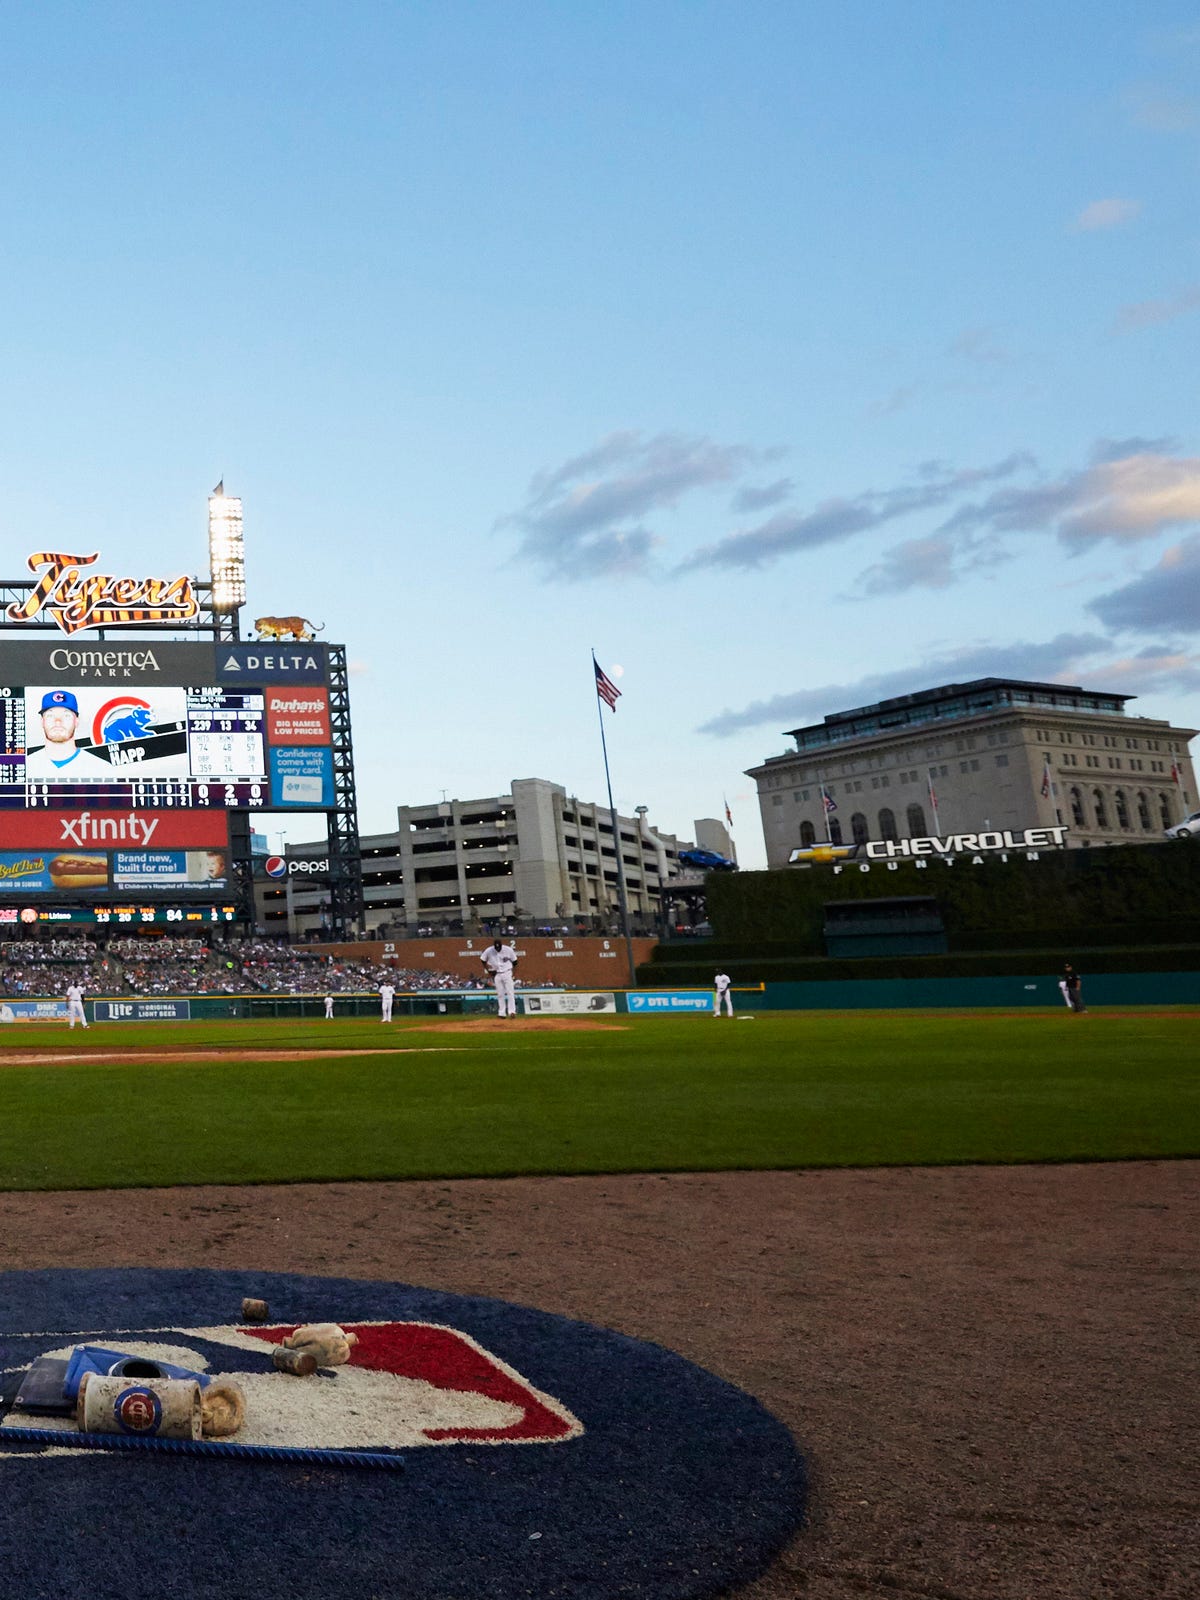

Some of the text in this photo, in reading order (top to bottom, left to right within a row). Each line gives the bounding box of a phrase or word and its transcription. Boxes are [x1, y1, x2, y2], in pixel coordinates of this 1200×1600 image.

[7, 551, 200, 637] Tigers
[247, 656, 318, 670] DELTA
[81, 668, 132, 676] PARK
[202, 687, 223, 696] HAPP
[270, 699, 325, 710] Dunham's
[191, 720, 211, 731] .239
[220, 720, 232, 731] 13
[245, 720, 257, 731] 34
[110, 747, 146, 766] HAPP
[276, 750, 324, 758] Confidence
[306, 758, 324, 766] with
[224, 764, 234, 772] 14
[180, 784, 186, 794] 2
[198, 784, 261, 798] 0 2 0
[153, 796, 159, 806] 3
[180, 796, 186, 806] 2
[60, 812, 160, 846] xfinity
[866, 826, 1068, 858] CHEVROLET
[118, 854, 172, 863] Brand new,
[833, 852, 1040, 875] FOUNTAIN
[20, 858, 45, 872] Park
[118, 864, 177, 872] built for me!
[288, 859, 329, 874] pepsi
[97, 913, 155, 922] 13 20 33
[166, 909, 183, 921] 84
[210, 912, 233, 921] 2 6
[385, 944, 395, 952] 23
[467, 940, 472, 948] 5
[510, 940, 516, 949] 2
[554, 940, 563, 949] 16
[603, 940, 610, 949] 6
[648, 998, 707, 1008] DTE Energy
[108, 1004, 133, 1019] Lite
